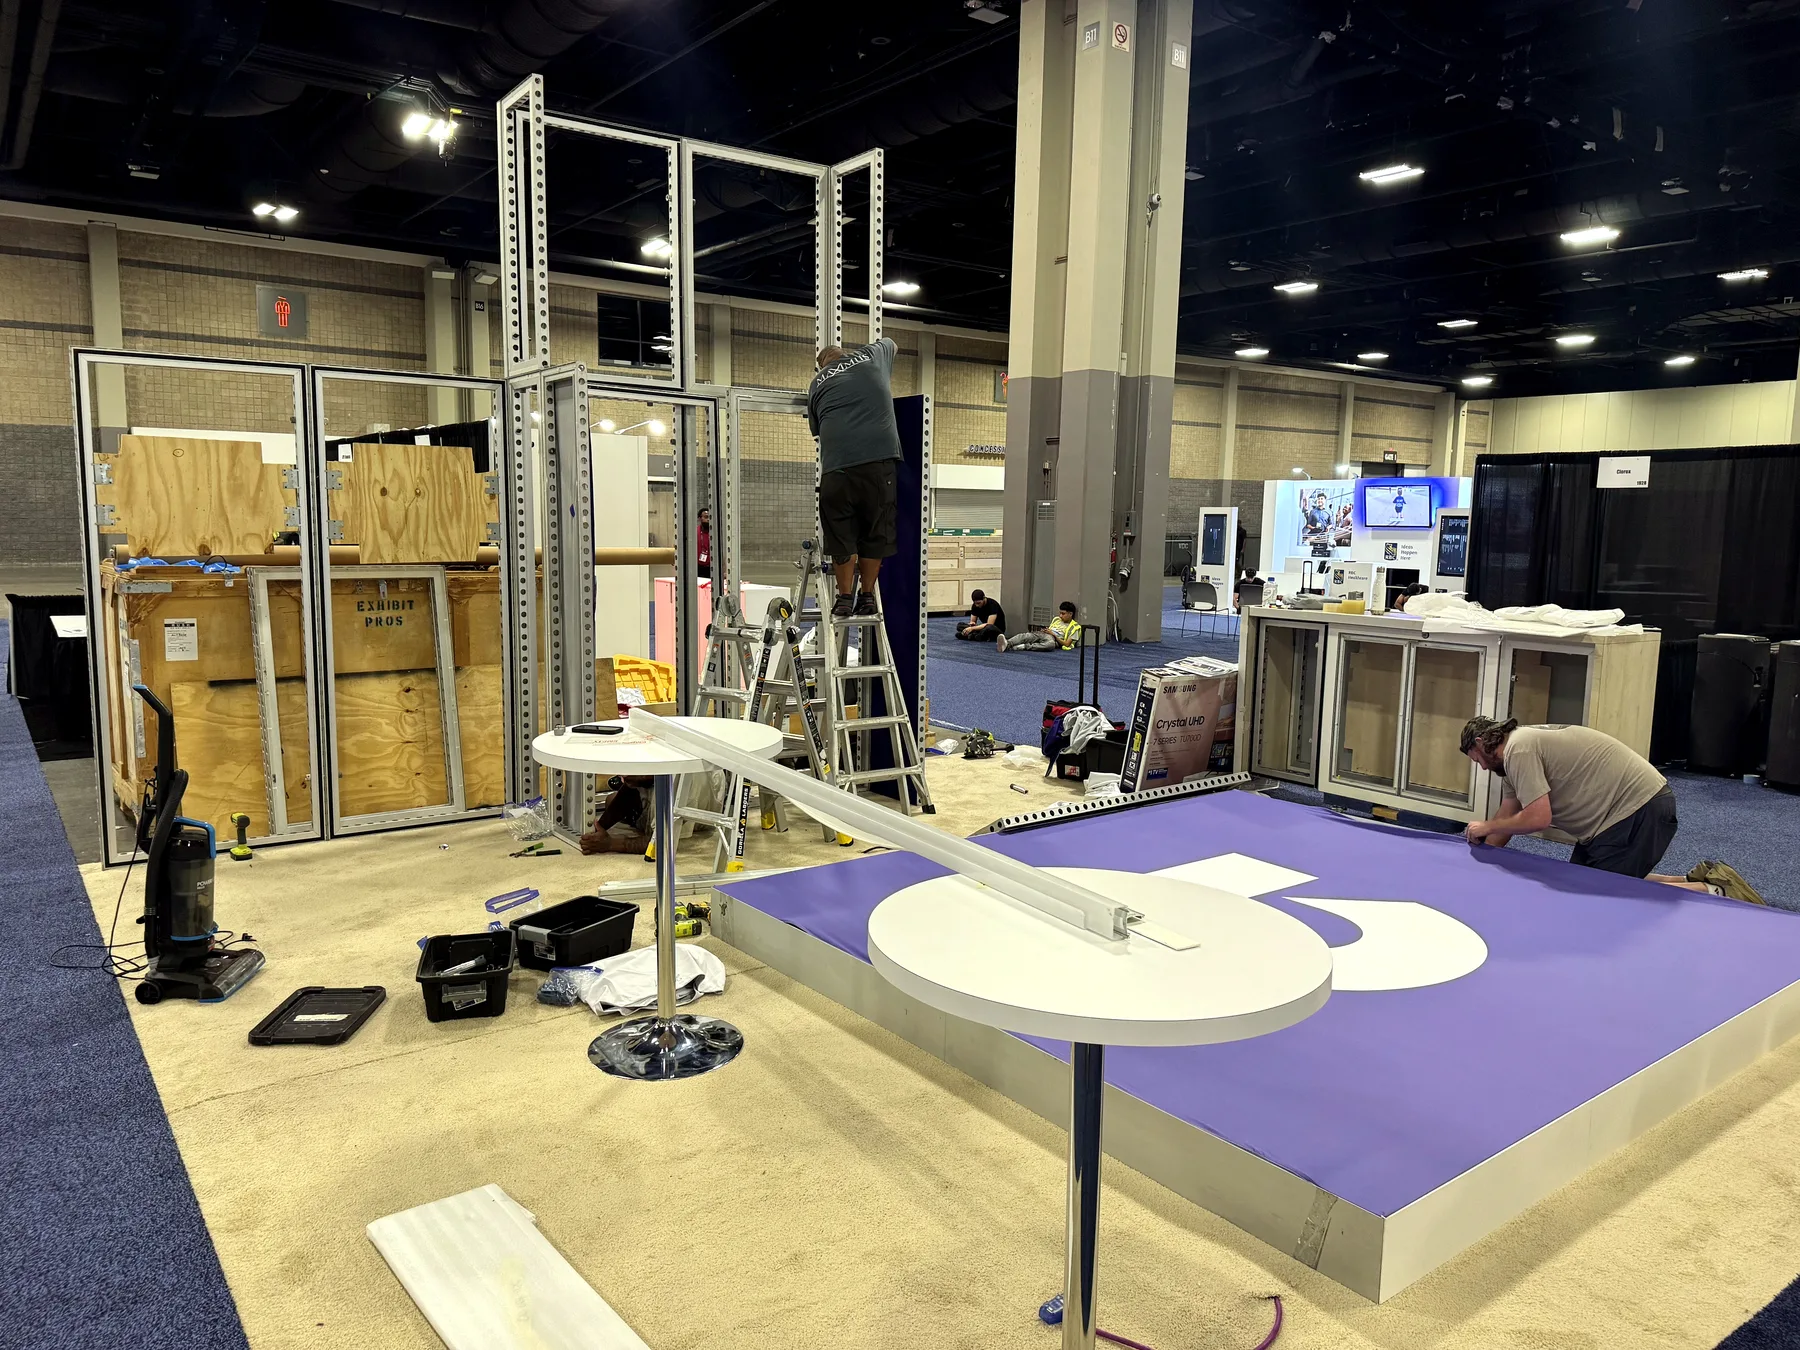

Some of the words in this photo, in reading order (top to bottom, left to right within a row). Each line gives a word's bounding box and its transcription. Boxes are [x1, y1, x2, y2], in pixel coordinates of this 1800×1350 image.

[1085, 28, 1097, 44] B11
[1174, 48, 1184, 63] B11
[816, 354, 870, 388] MAXIMUS
[357, 600, 415, 612] EXHIBIT
[365, 615, 403, 628] PROS
[1156, 717, 1188, 730] Crystal
[1188, 715, 1205, 726] UHD
[1157, 736, 1177, 745] SERIES
